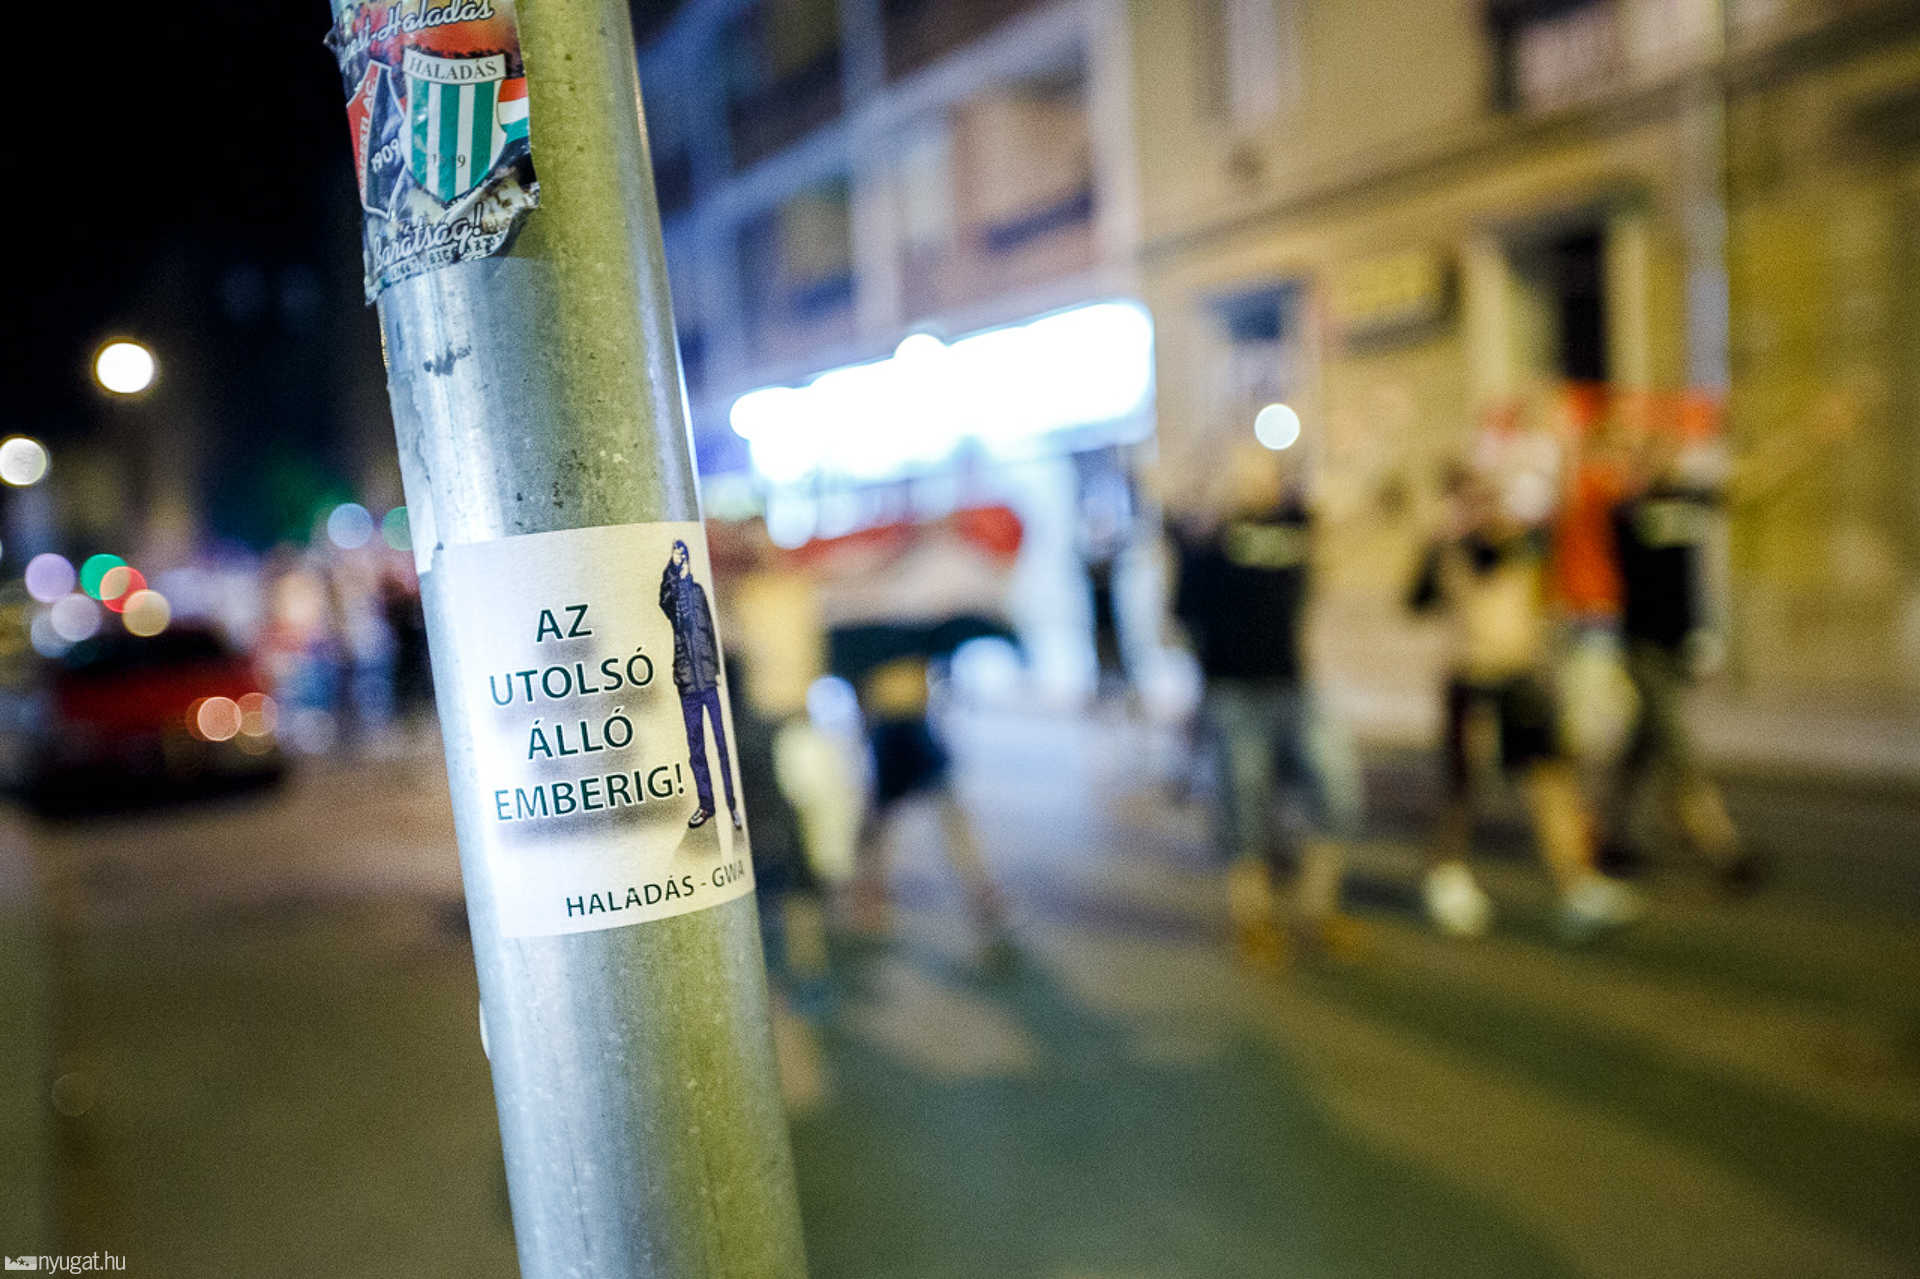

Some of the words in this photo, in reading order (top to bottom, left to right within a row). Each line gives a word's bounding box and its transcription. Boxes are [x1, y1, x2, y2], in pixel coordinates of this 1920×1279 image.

[409, 57, 498, 81] HALADÁS
[370, 138, 400, 173] 1909
[536, 604, 592, 642] AZ
[489, 646, 653, 706] UTOLSÓ
[528, 708, 633, 759] ÁLLÓ
[494, 763, 684, 821] EMBERIG!
[566, 875, 694, 917] HALADÁS
